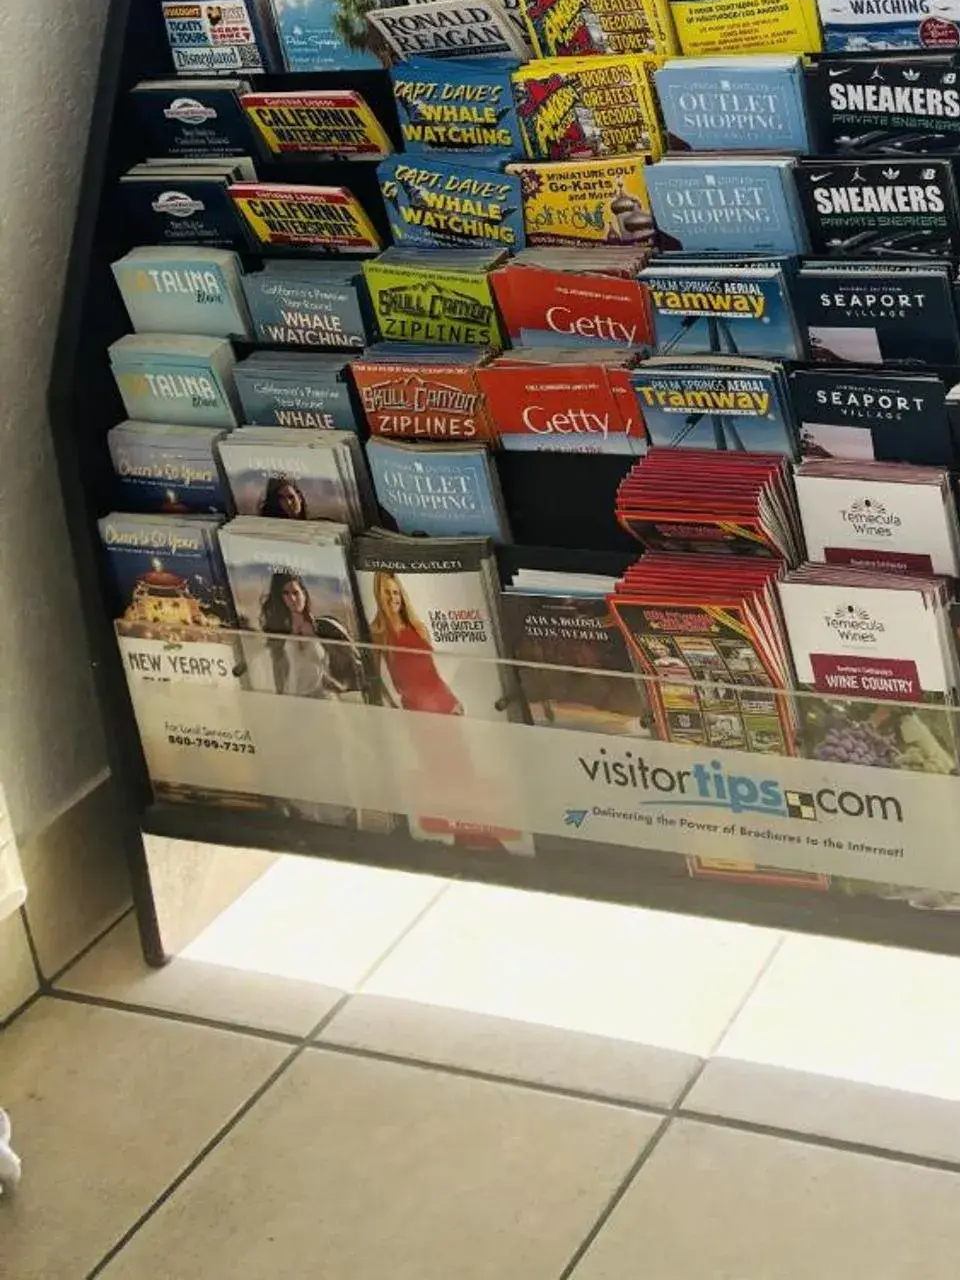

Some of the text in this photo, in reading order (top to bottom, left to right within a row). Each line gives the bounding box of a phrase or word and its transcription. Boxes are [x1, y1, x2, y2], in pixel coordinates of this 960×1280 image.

[380, 7, 489, 37] RONALD
[602, 13, 647, 31] RECORD
[399, 24, 504, 55] REAGAN
[175, 48, 239, 67] Disneyland
[394, 81, 503, 104] CAPT. DAVE'S
[679, 93, 778, 112] OUTLET
[829, 83, 960, 117] SNEAKERS
[255, 108, 367, 129] CALIFORNIA
[272, 128, 369, 147] WATERSPORTS
[546, 165, 637, 182] MINIATURE GOLF
[550, 180, 613, 193] Go-Karts
[568, 192, 587, 202] and
[813, 185, 944, 214] SNEAKERS
[820, 216, 948, 227] PRIVATE SNEAKERS
[650, 280, 763, 295] PALM SPRINGS AERIAL
[820, 293, 926, 307] SEAPORT
[281, 310, 342, 332] WHALE
[846, 310, 906, 318] VILLAGE
[385, 318, 491, 345] ZIPLINES
[546, 306, 637, 348] Getty
[362, 387, 476, 413] SKULL CANYON
[635, 385, 769, 415] Tramway
[816, 390, 924, 411] SEAPORT
[380, 416, 476, 436] ZIPLINES
[522, 405, 608, 439] Getty
[839, 510, 902, 527] Temecula
[431, 619, 485, 631] FOR OUTLET
[434, 630, 487, 643] SHOPPING
[837, 630, 876, 643] Wines
[128, 652, 228, 677] NEW YEAR'S
[825, 674, 913, 694] WINE COUNTRY
[592, 806, 653, 826] Delivering
[656, 812, 677, 826] the
[680, 817, 718, 833] Power
[723, 822, 735, 835] of
[740, 827, 801, 845] Brochures
[806, 836, 819, 847] to
[823, 837, 843, 850] the
